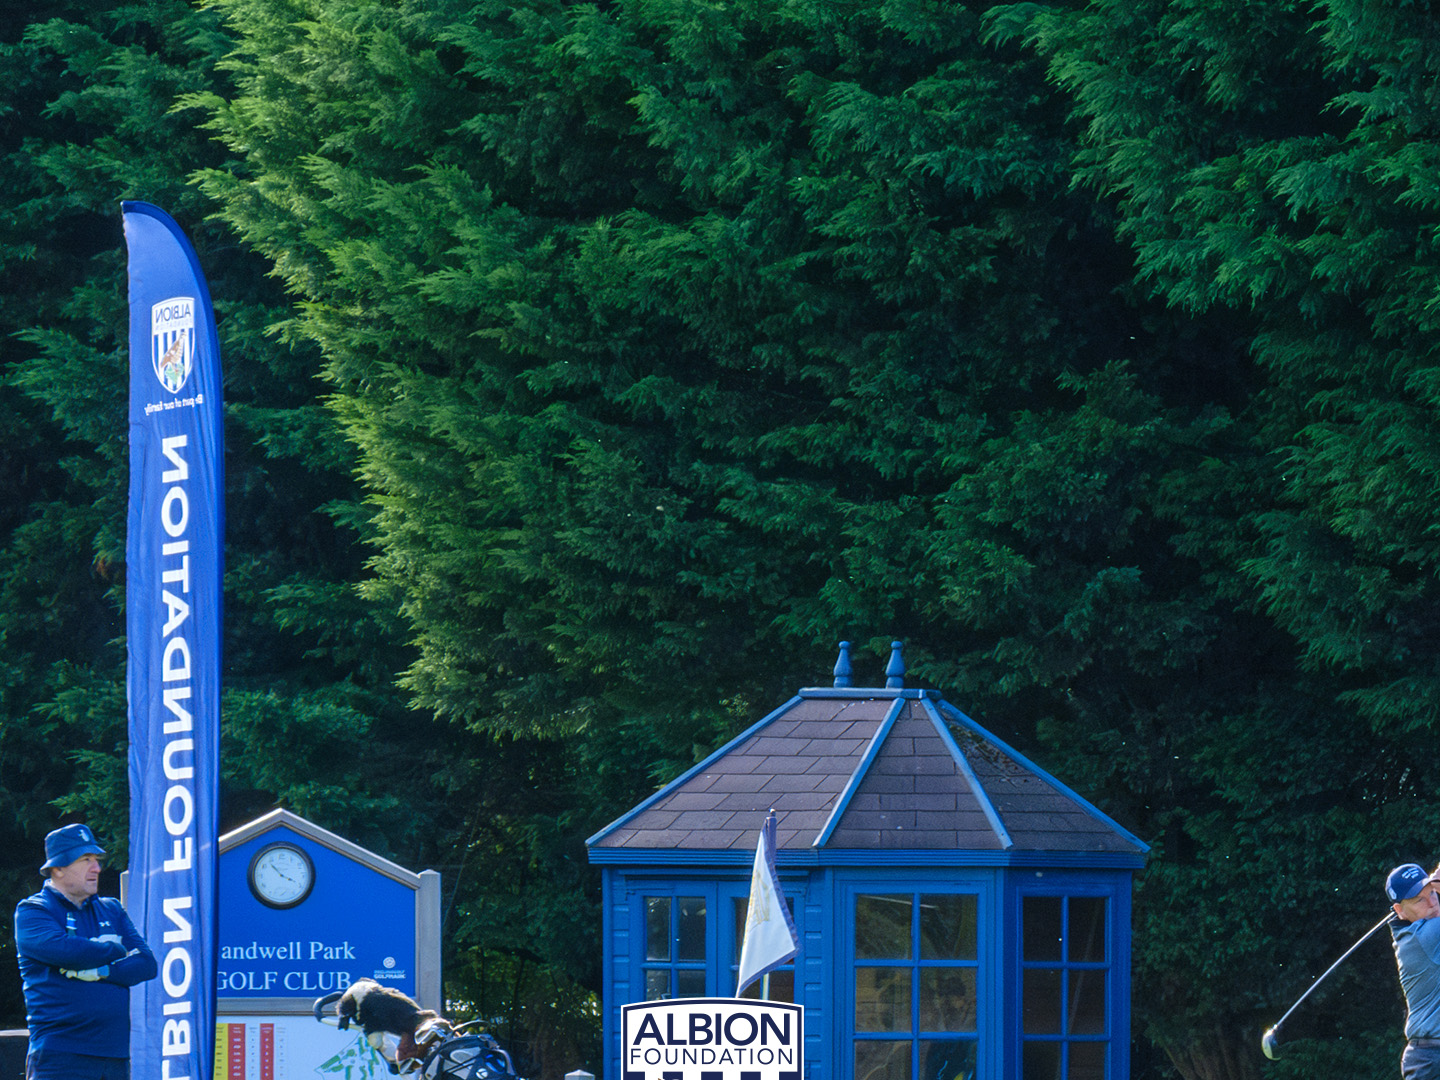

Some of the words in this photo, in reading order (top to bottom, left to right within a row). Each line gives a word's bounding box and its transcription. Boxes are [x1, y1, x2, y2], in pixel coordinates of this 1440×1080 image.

[220, 941, 301, 960] andwell
[309, 941, 356, 960] Park
[217, 971, 278, 991] GOLF
[284, 971, 352, 991] CLUB
